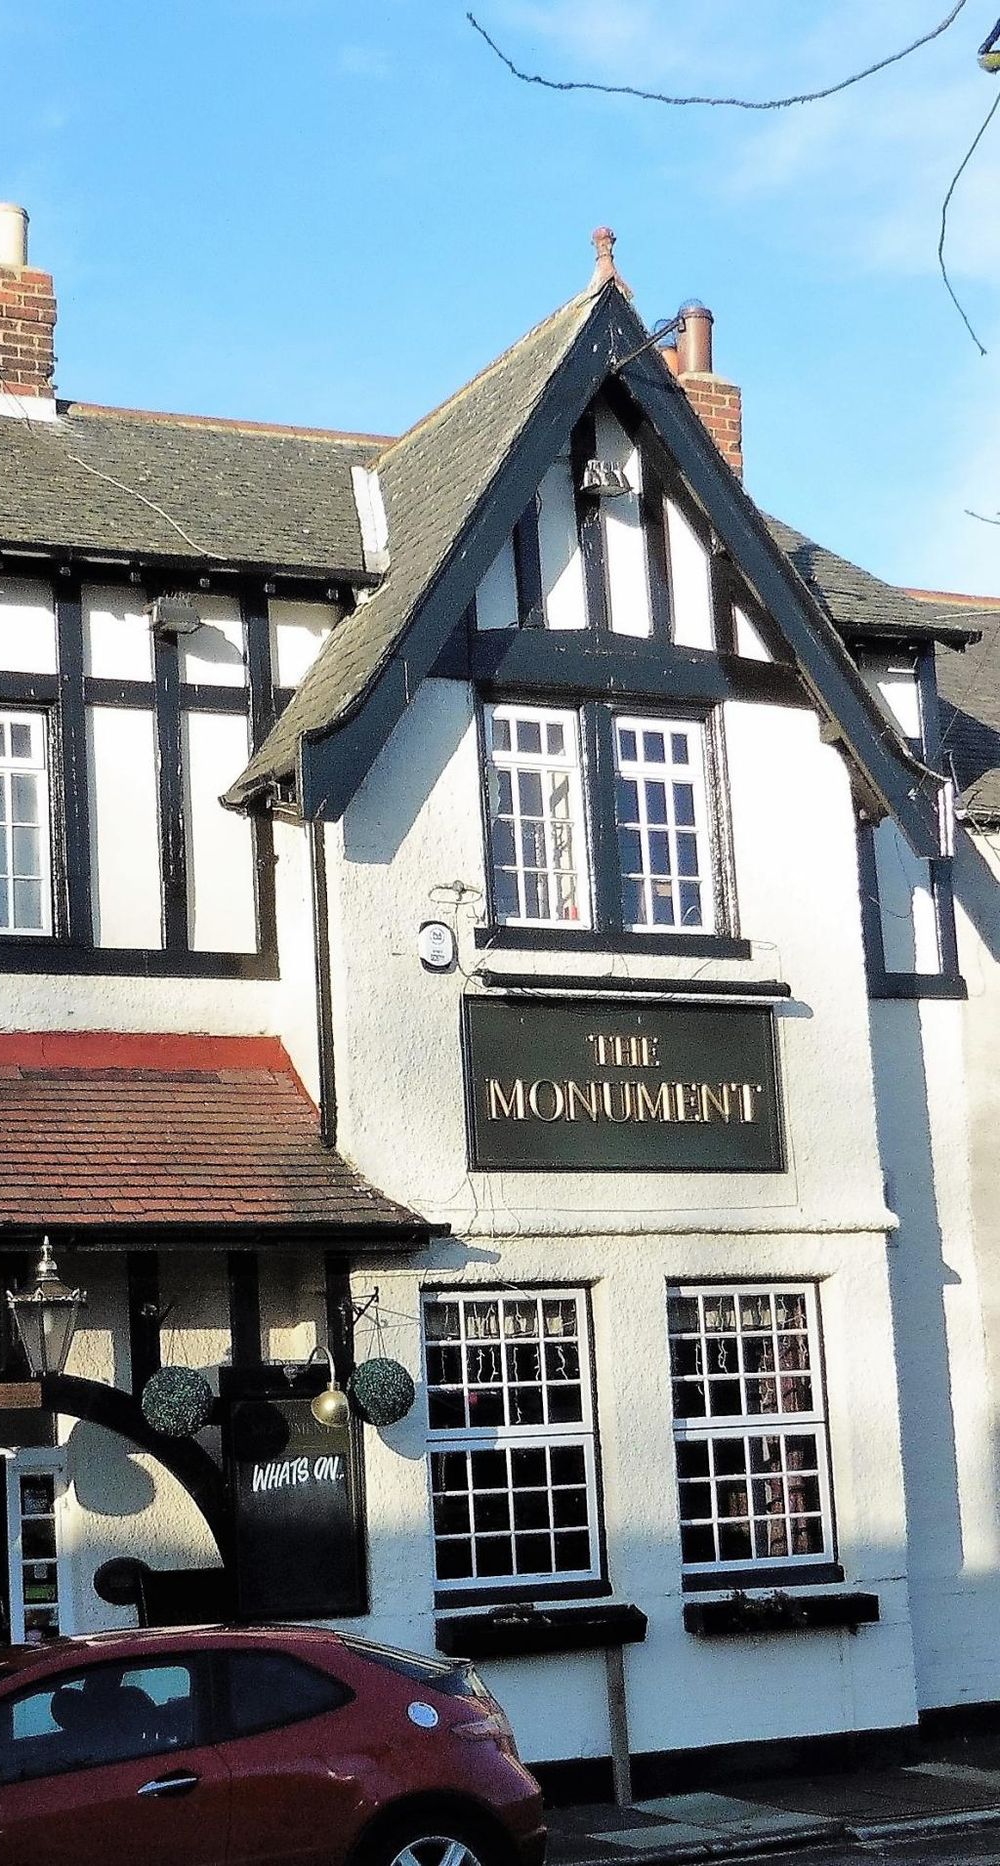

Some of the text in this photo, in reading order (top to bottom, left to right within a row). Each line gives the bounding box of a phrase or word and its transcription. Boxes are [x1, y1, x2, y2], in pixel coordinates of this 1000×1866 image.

[586, 1034, 660, 1066] THE
[485, 1078, 762, 1123] MONUMENT
[252, 1456, 310, 1493] WHATS
